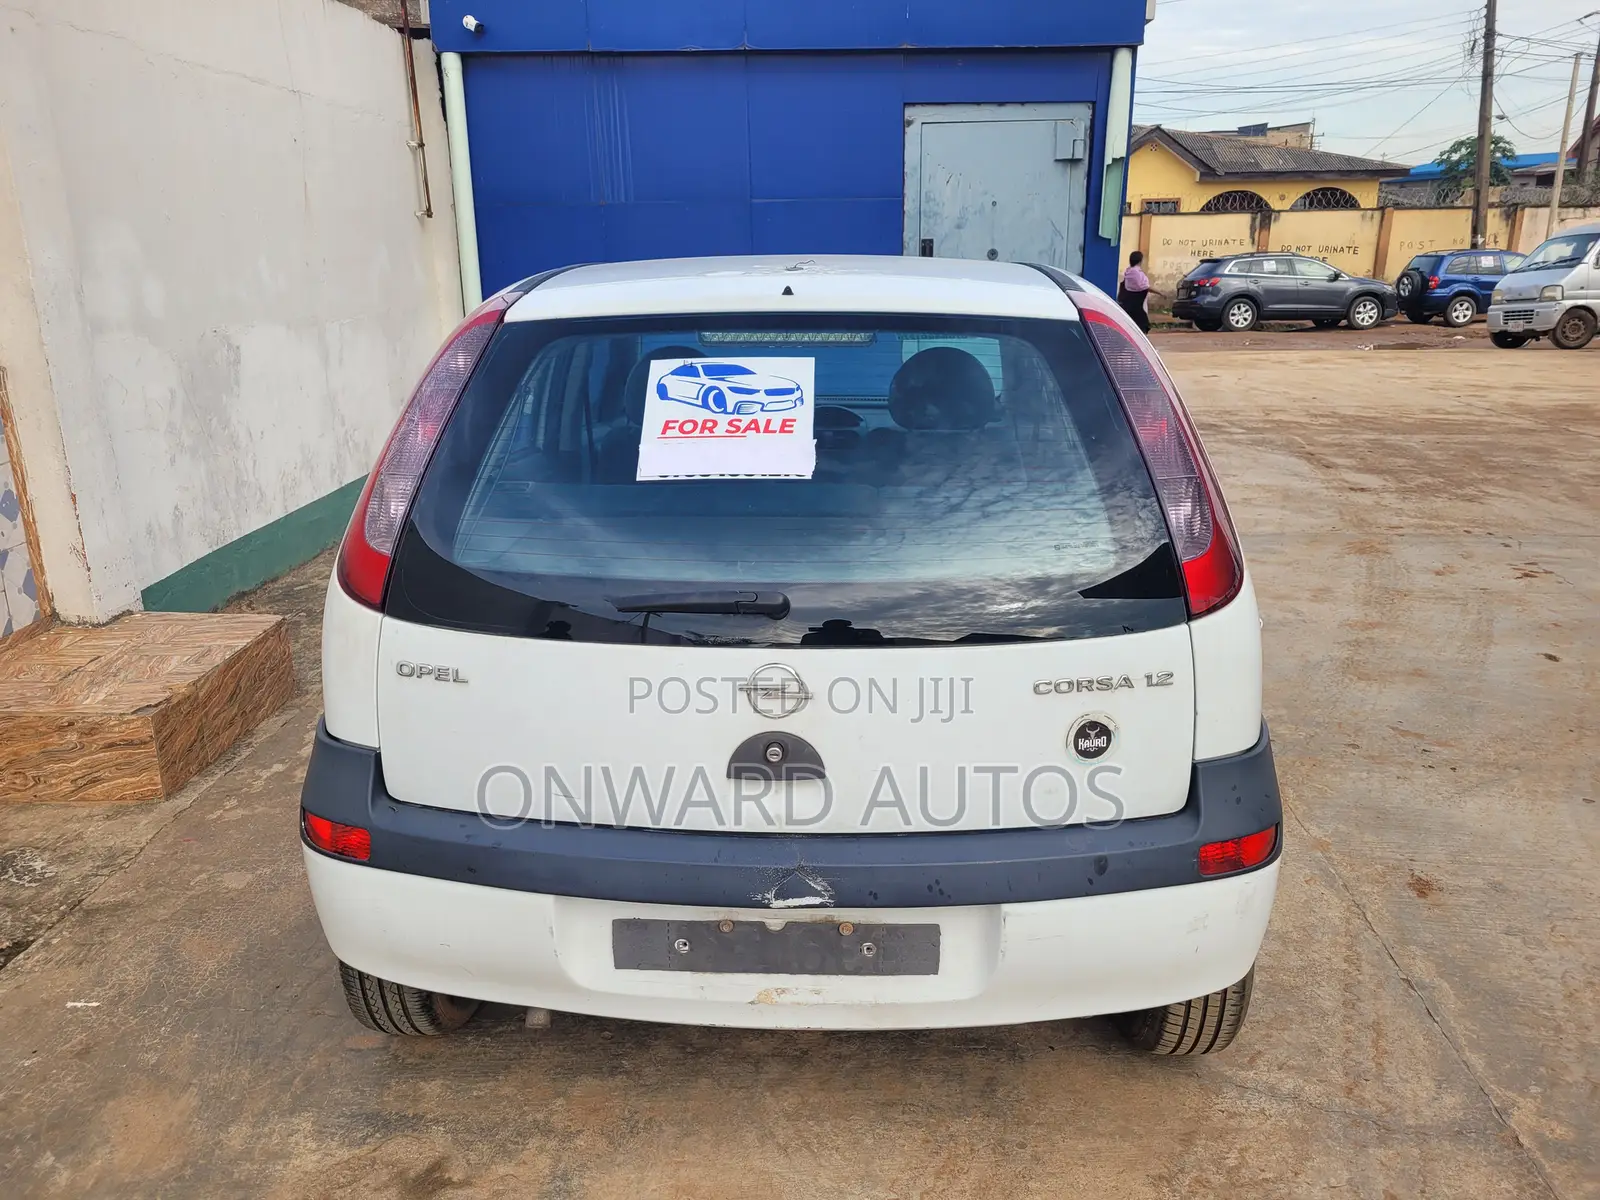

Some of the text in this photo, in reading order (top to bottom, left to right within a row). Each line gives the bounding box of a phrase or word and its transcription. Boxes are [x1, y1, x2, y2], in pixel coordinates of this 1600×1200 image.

[1162, 238, 1245, 247] DO NOT URINATE
[1280, 244, 1292, 252] DO
[1318, 245, 1359, 255] URINATE
[661, 418, 797, 435] FOR SALE
[396, 660, 469, 684] OPEL
[1033, 674, 1135, 695] CORSA
